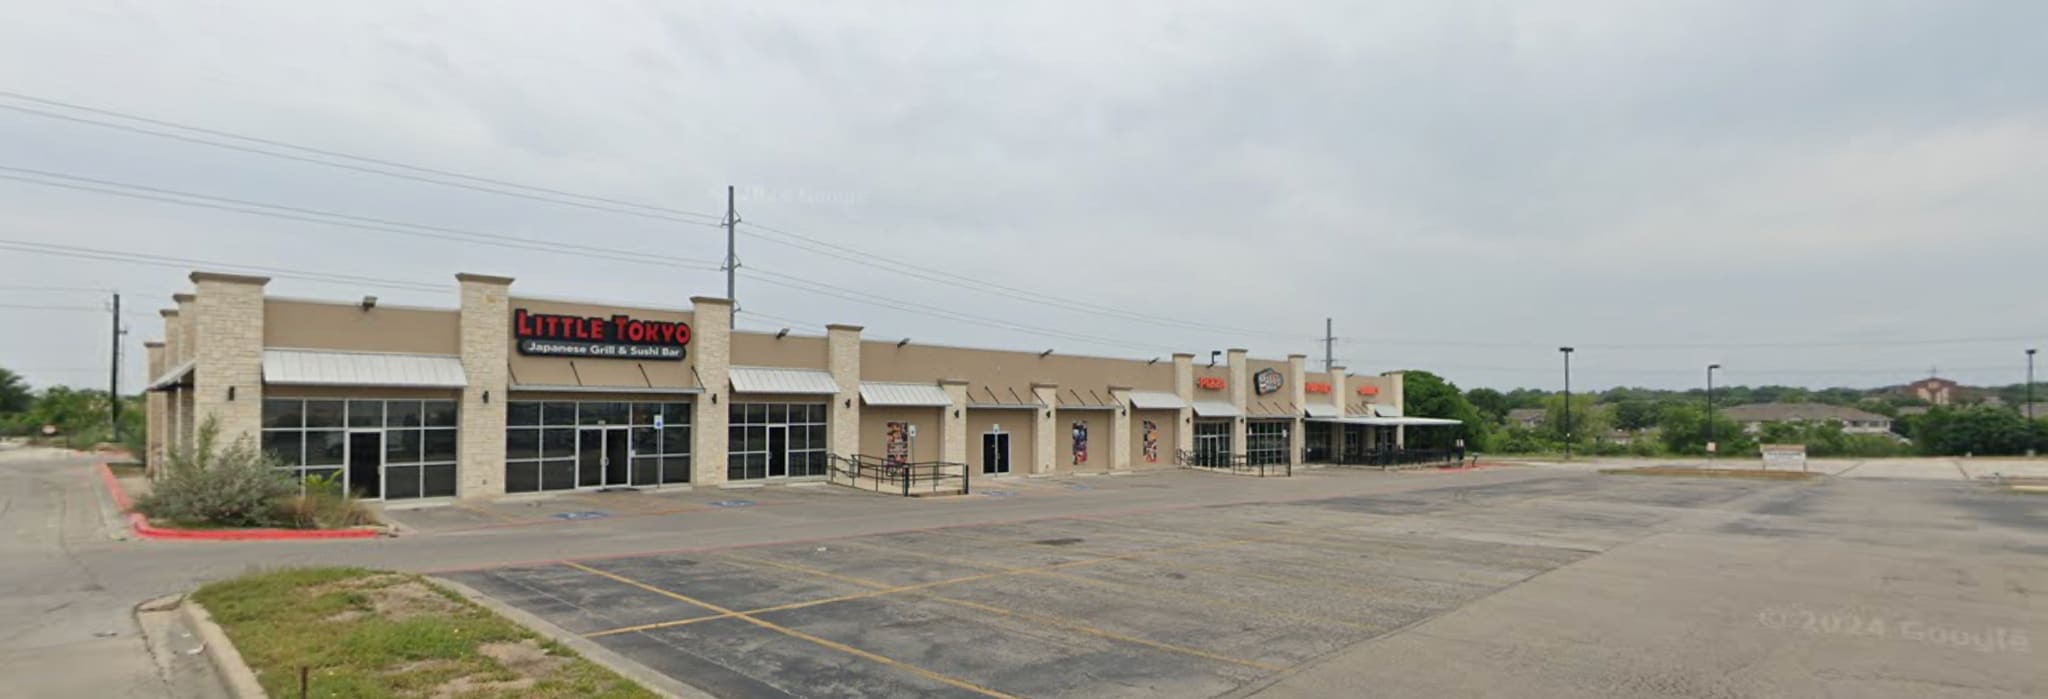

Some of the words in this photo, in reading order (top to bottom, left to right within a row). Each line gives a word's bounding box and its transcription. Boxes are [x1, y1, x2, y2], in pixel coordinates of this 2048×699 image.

[517, 310, 604, 340] LITTLE
[614, 316, 692, 345] TOKYO
[528, 342, 587, 354] Japanese
[590, 343, 615, 355] Grill
[618, 344, 628, 356] &
[630, 345, 659, 356] Sushi
[662, 347, 680, 357] Bar
